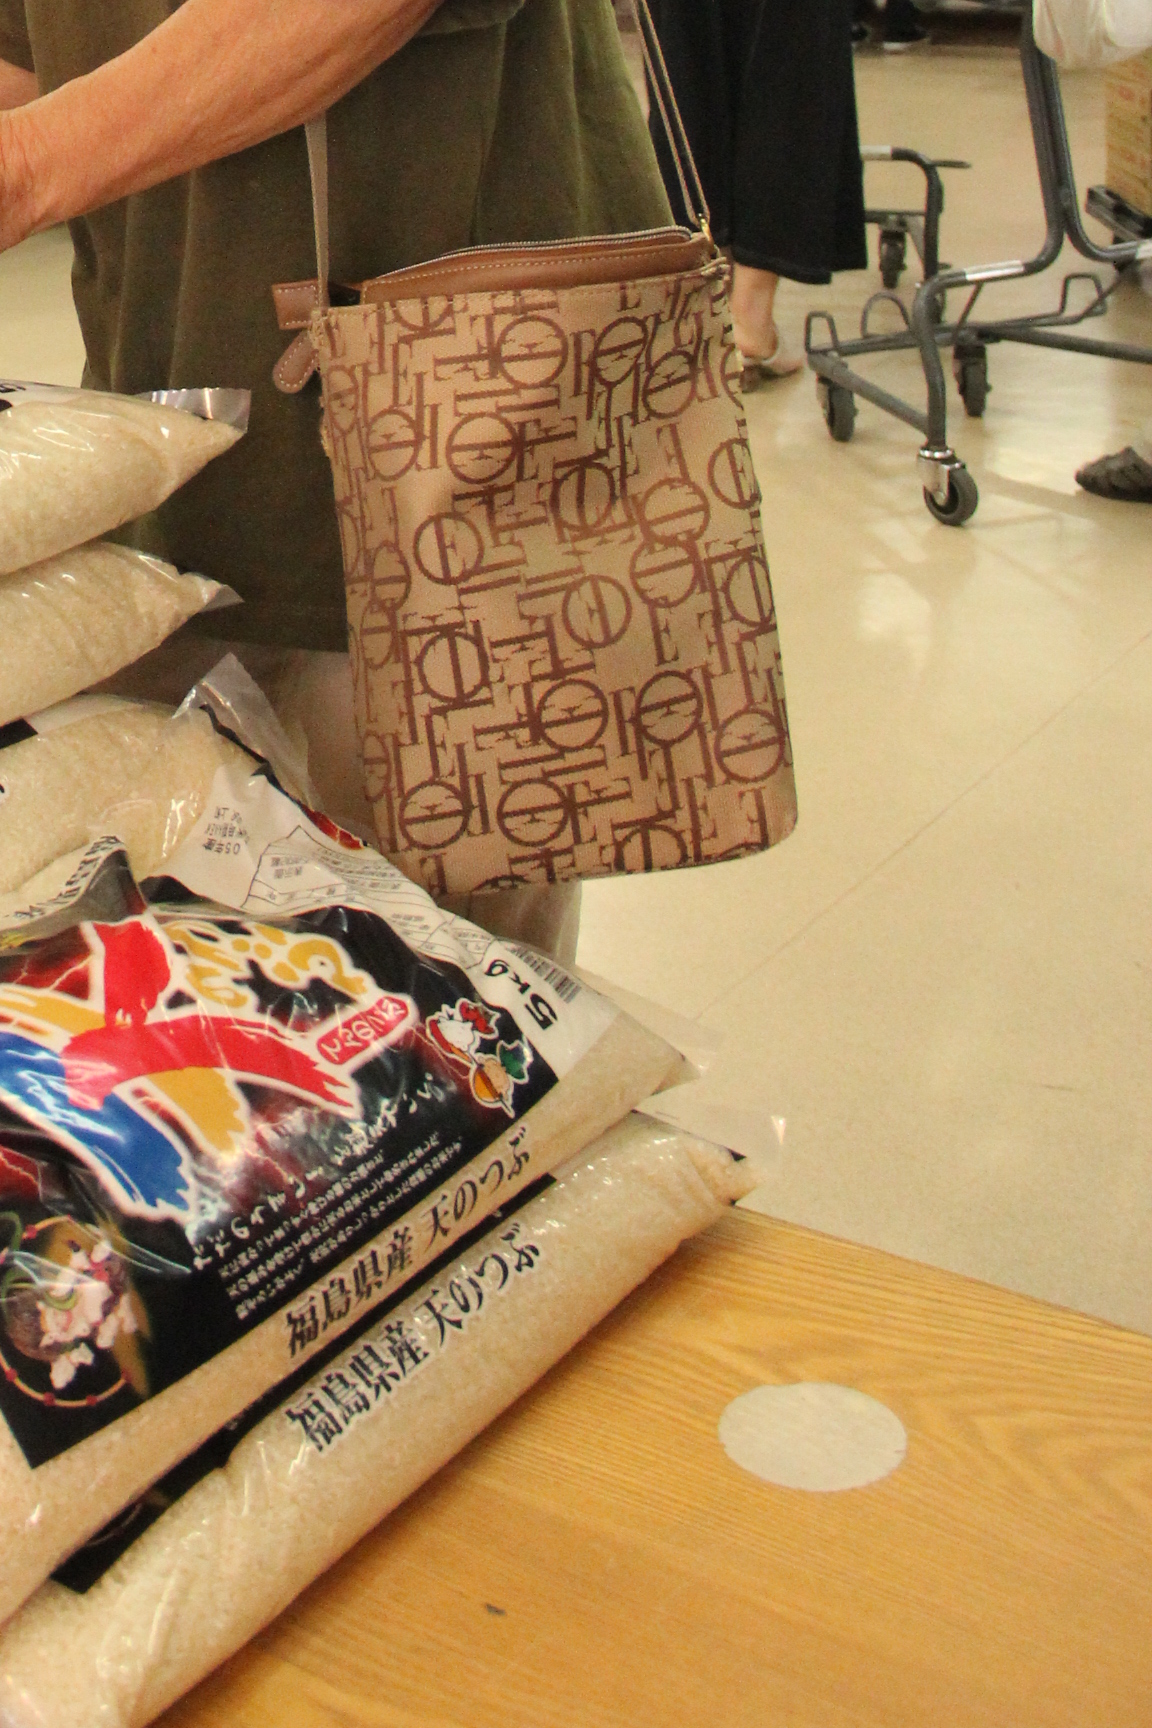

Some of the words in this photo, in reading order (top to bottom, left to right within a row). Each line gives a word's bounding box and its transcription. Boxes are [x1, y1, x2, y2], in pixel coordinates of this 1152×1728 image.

[285, 1321, 429, 1452] 福島県産
[414, 1222, 540, 1347] 天のつぶ
[286, 1226, 413, 1358] 福島県産
[420, 1126, 530, 1253] 天のつぶ
